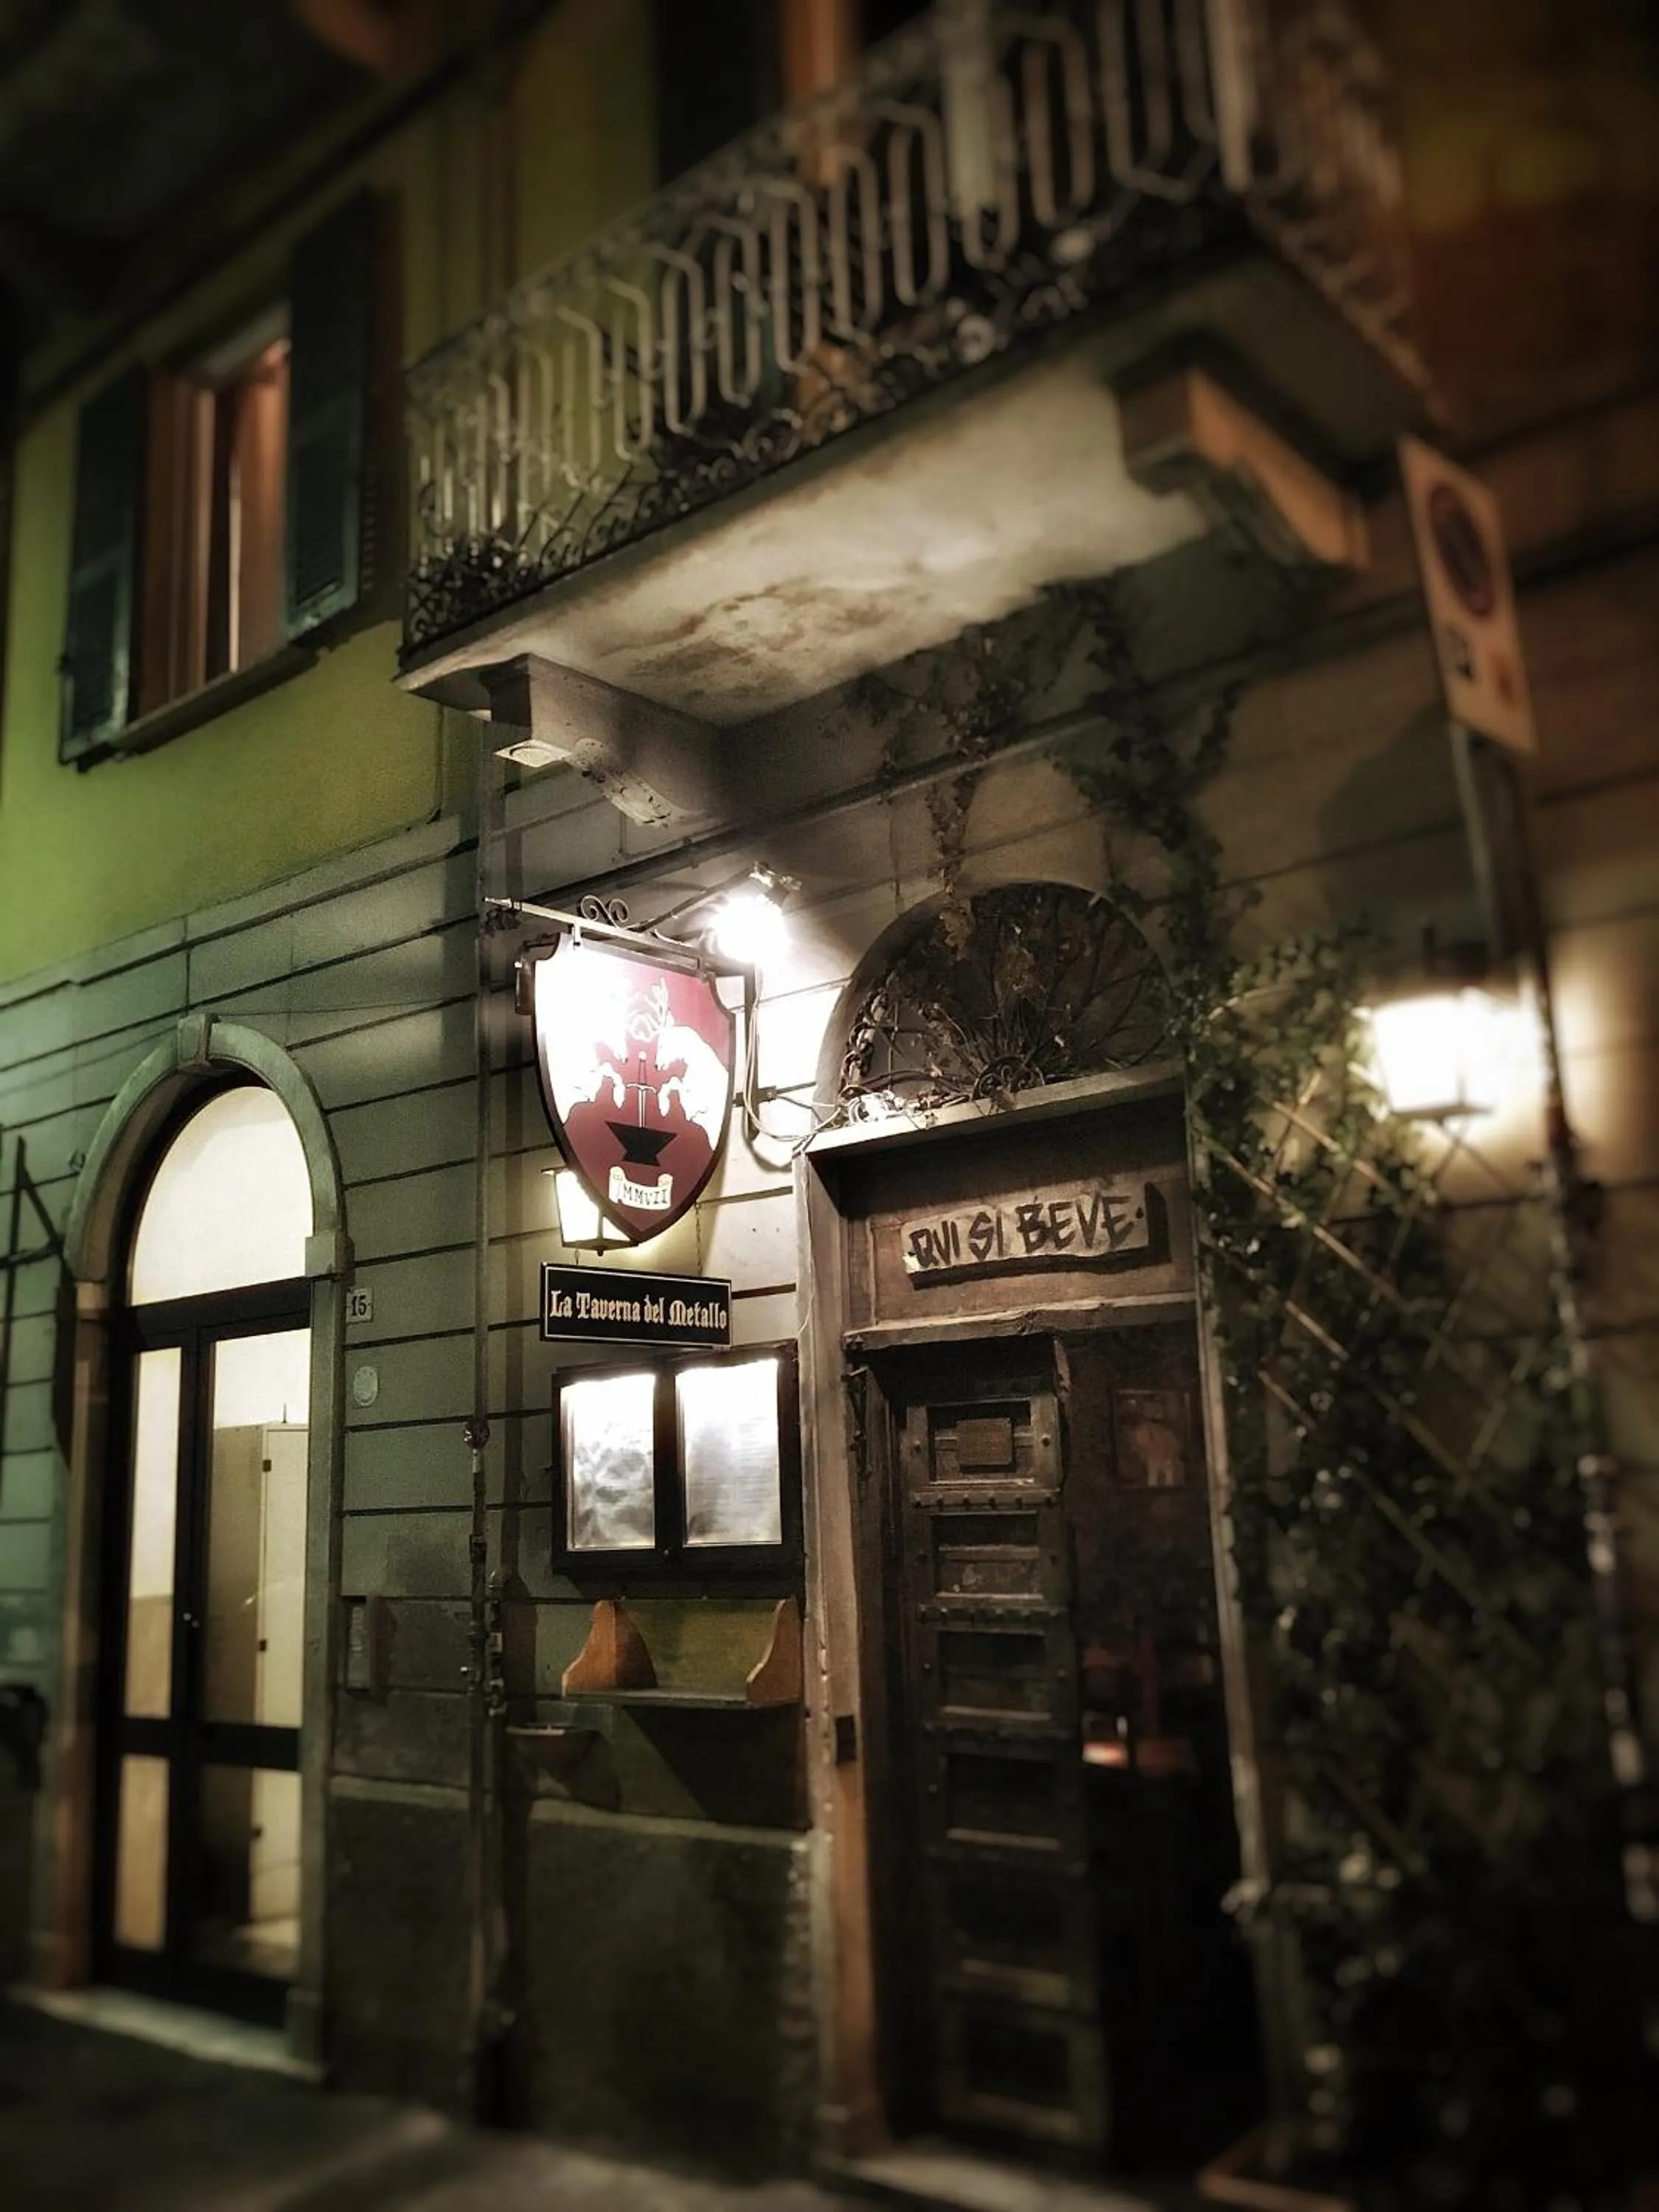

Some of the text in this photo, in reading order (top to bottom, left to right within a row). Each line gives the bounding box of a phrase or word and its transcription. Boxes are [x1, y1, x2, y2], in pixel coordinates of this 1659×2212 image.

[623, 1183, 668, 1205] MMVII
[967, 1208, 1004, 1262] SI
[352, 1295, 366, 1316] 15
[550, 1290, 727, 1329] La Taverna del Metallo
